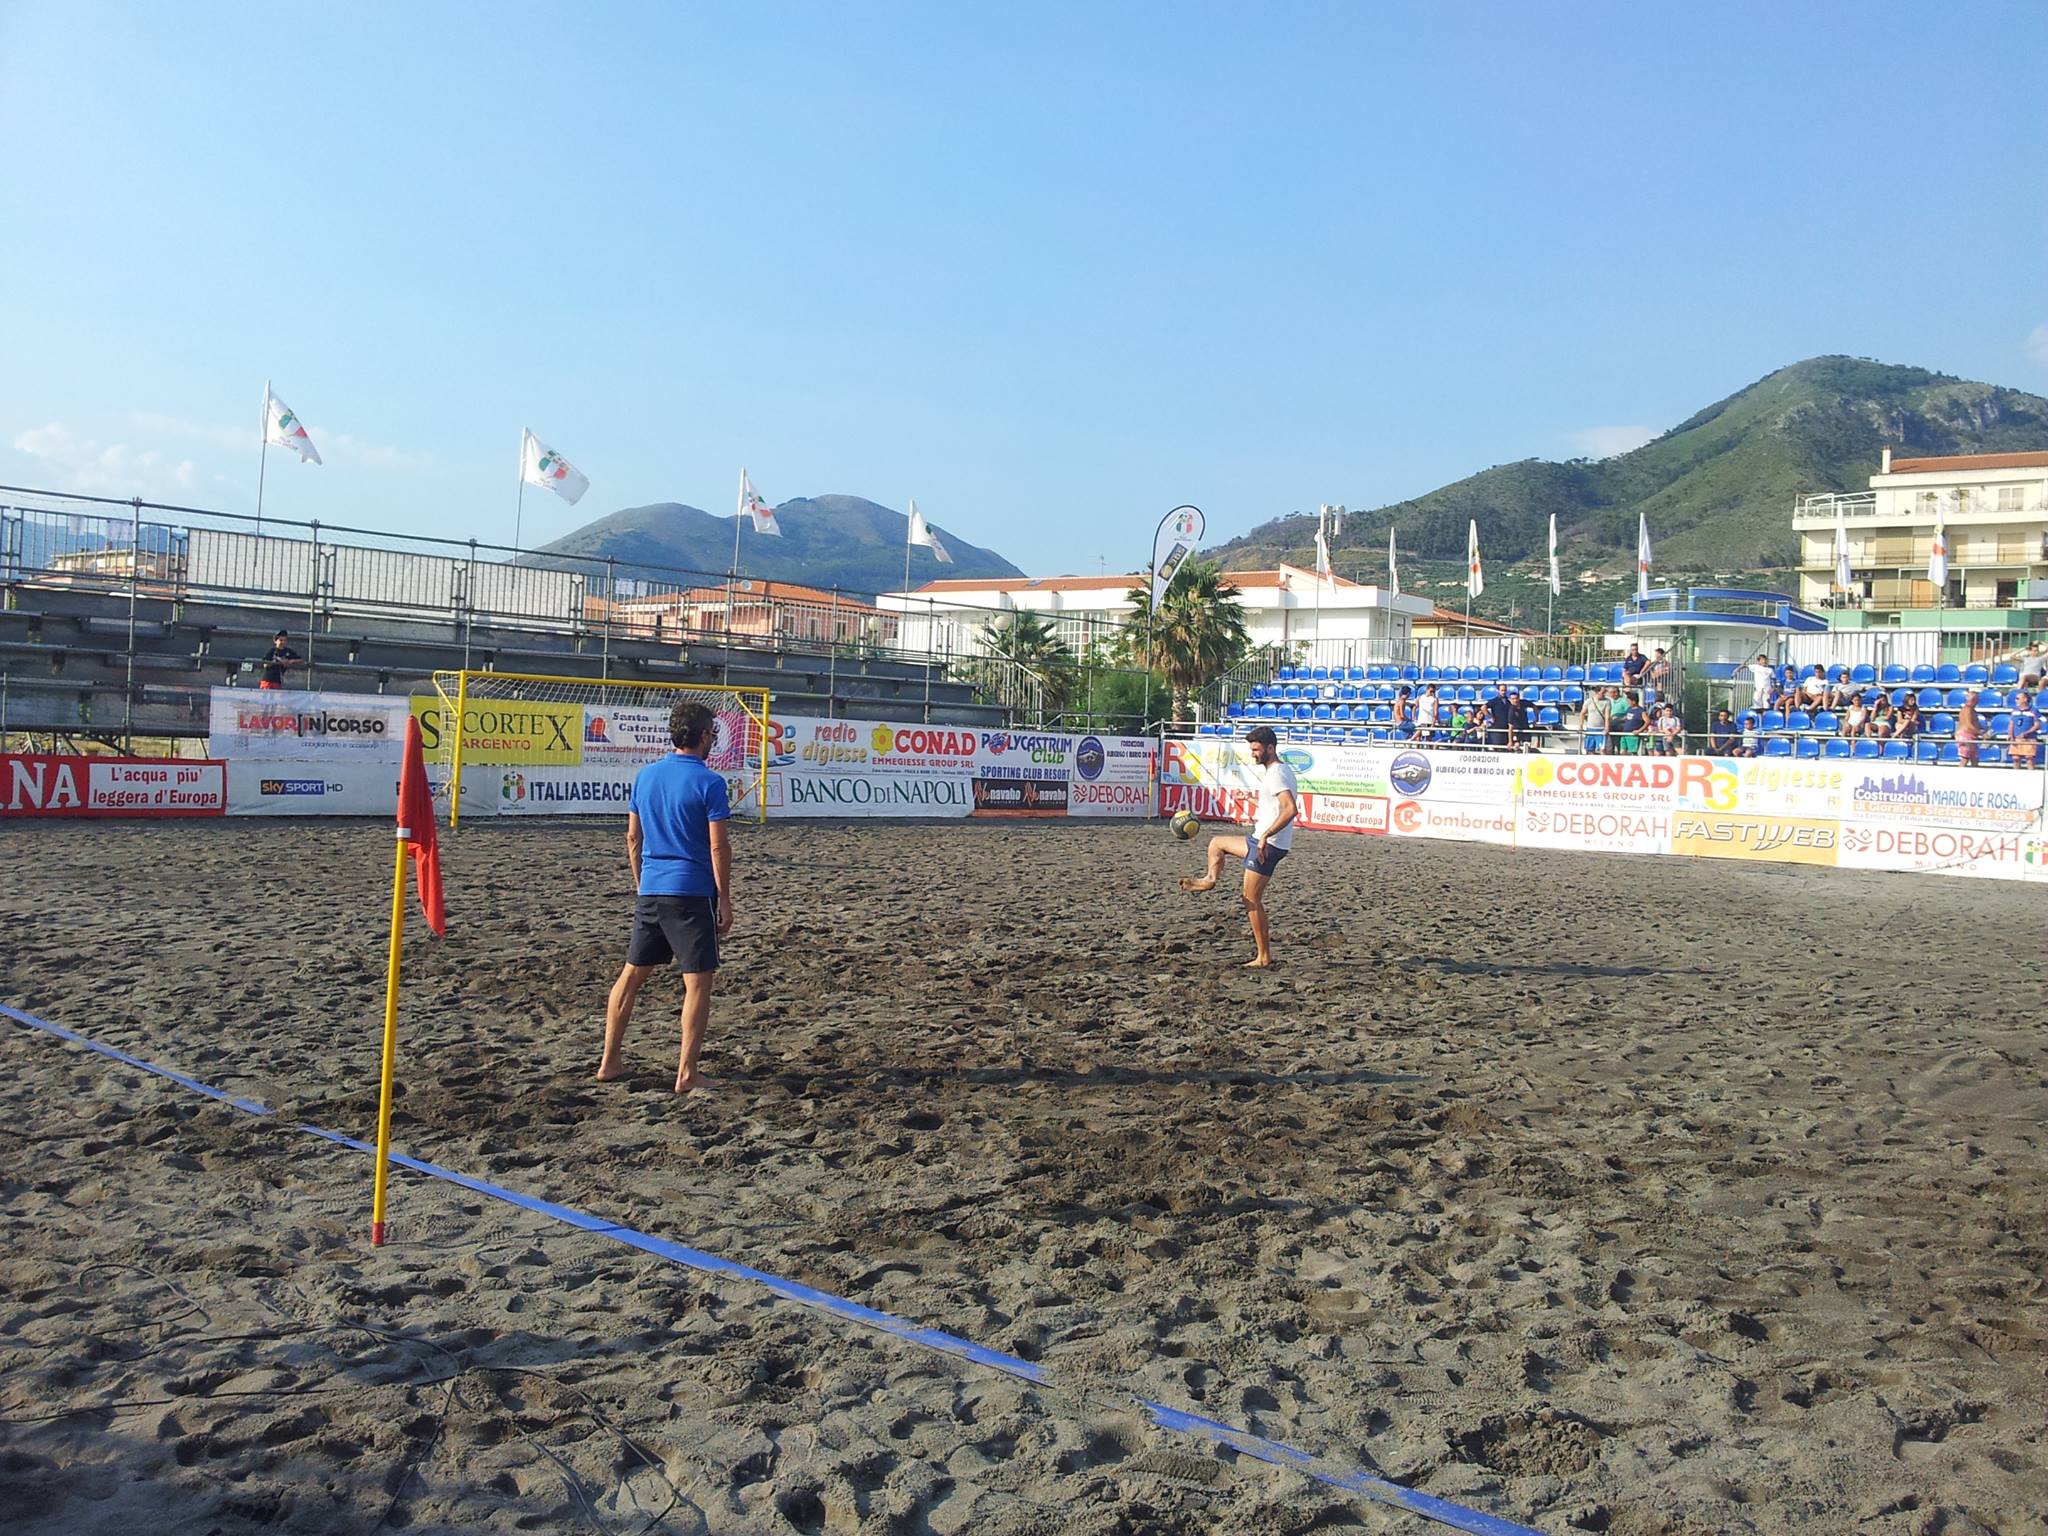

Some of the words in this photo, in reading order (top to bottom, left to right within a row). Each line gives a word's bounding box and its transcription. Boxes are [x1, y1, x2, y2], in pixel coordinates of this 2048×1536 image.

[612, 711, 650, 722] Santa
[814, 723, 857, 743] radio
[895, 729, 977, 756] CONAD
[981, 732, 1073, 754] POLYCASTRUM
[802, 740, 868, 766] digiesse
[1031, 748, 1065, 765] Club
[872, 757, 926, 767] EMMEGIESSE
[929, 759, 958, 768] GROUP
[961, 759, 975, 769] SRL
[980, 765, 1022, 779] SPORTING
[1023, 767, 1043, 780] CLUB
[1044, 768, 1071, 780] RESORT
[1473, 766, 1495, 776] MARIO
[1496, 767, 1505, 776] DE
[0, 759, 82, 810] NA
[111, 767, 168, 785] L'acqua
[176, 767, 203, 784] piu'
[1556, 761, 1675, 789] CONAD
[1677, 758, 1740, 811] R3
[1743, 764, 1843, 792] digiesse
[93, 789, 149, 807] leggera
[154, 788, 218, 807] d'Europa
[262, 781, 285, 795] sky
[285, 781, 323, 793] SPORT
[326, 783, 344, 792] HD
[790, 777, 872, 804] BANCO
[874, 786, 891, 804] DI
[892, 778, 967, 805] NAPOLI
[990, 787, 1021, 801] navaho
[1039, 787, 1067, 801] navaho
[1088, 785, 1150, 805] DEBORAH
[1526, 789, 1599, 800] EMMEGIESSE
[1603, 792, 1646, 802] GROUP
[1651, 793, 1672, 803] SRL
[1323, 797, 1355, 810] L'acqua
[1854, 787, 1929, 804] Costruzioni
[1931, 789, 1968, 807] MARIO
[1970, 791, 1985, 808] DE
[1986, 792, 2018, 810] ROSA
[1313, 810, 1344, 824] leggera
[1346, 813, 1383, 826] d'Europa
[1427, 809, 1517, 833] lombarda
[1925, 805, 1975, 818] Stefano
[1975, 808, 1991, 819] De
[1993, 809, 2028, 820] Rosa
[1553, 813, 1668, 838] DEBORAH
[1674, 819, 1836, 851] FASTWEB
[1584, 839, 1635, 848] MILANO
[1876, 830, 2020, 862] DEBORAH
